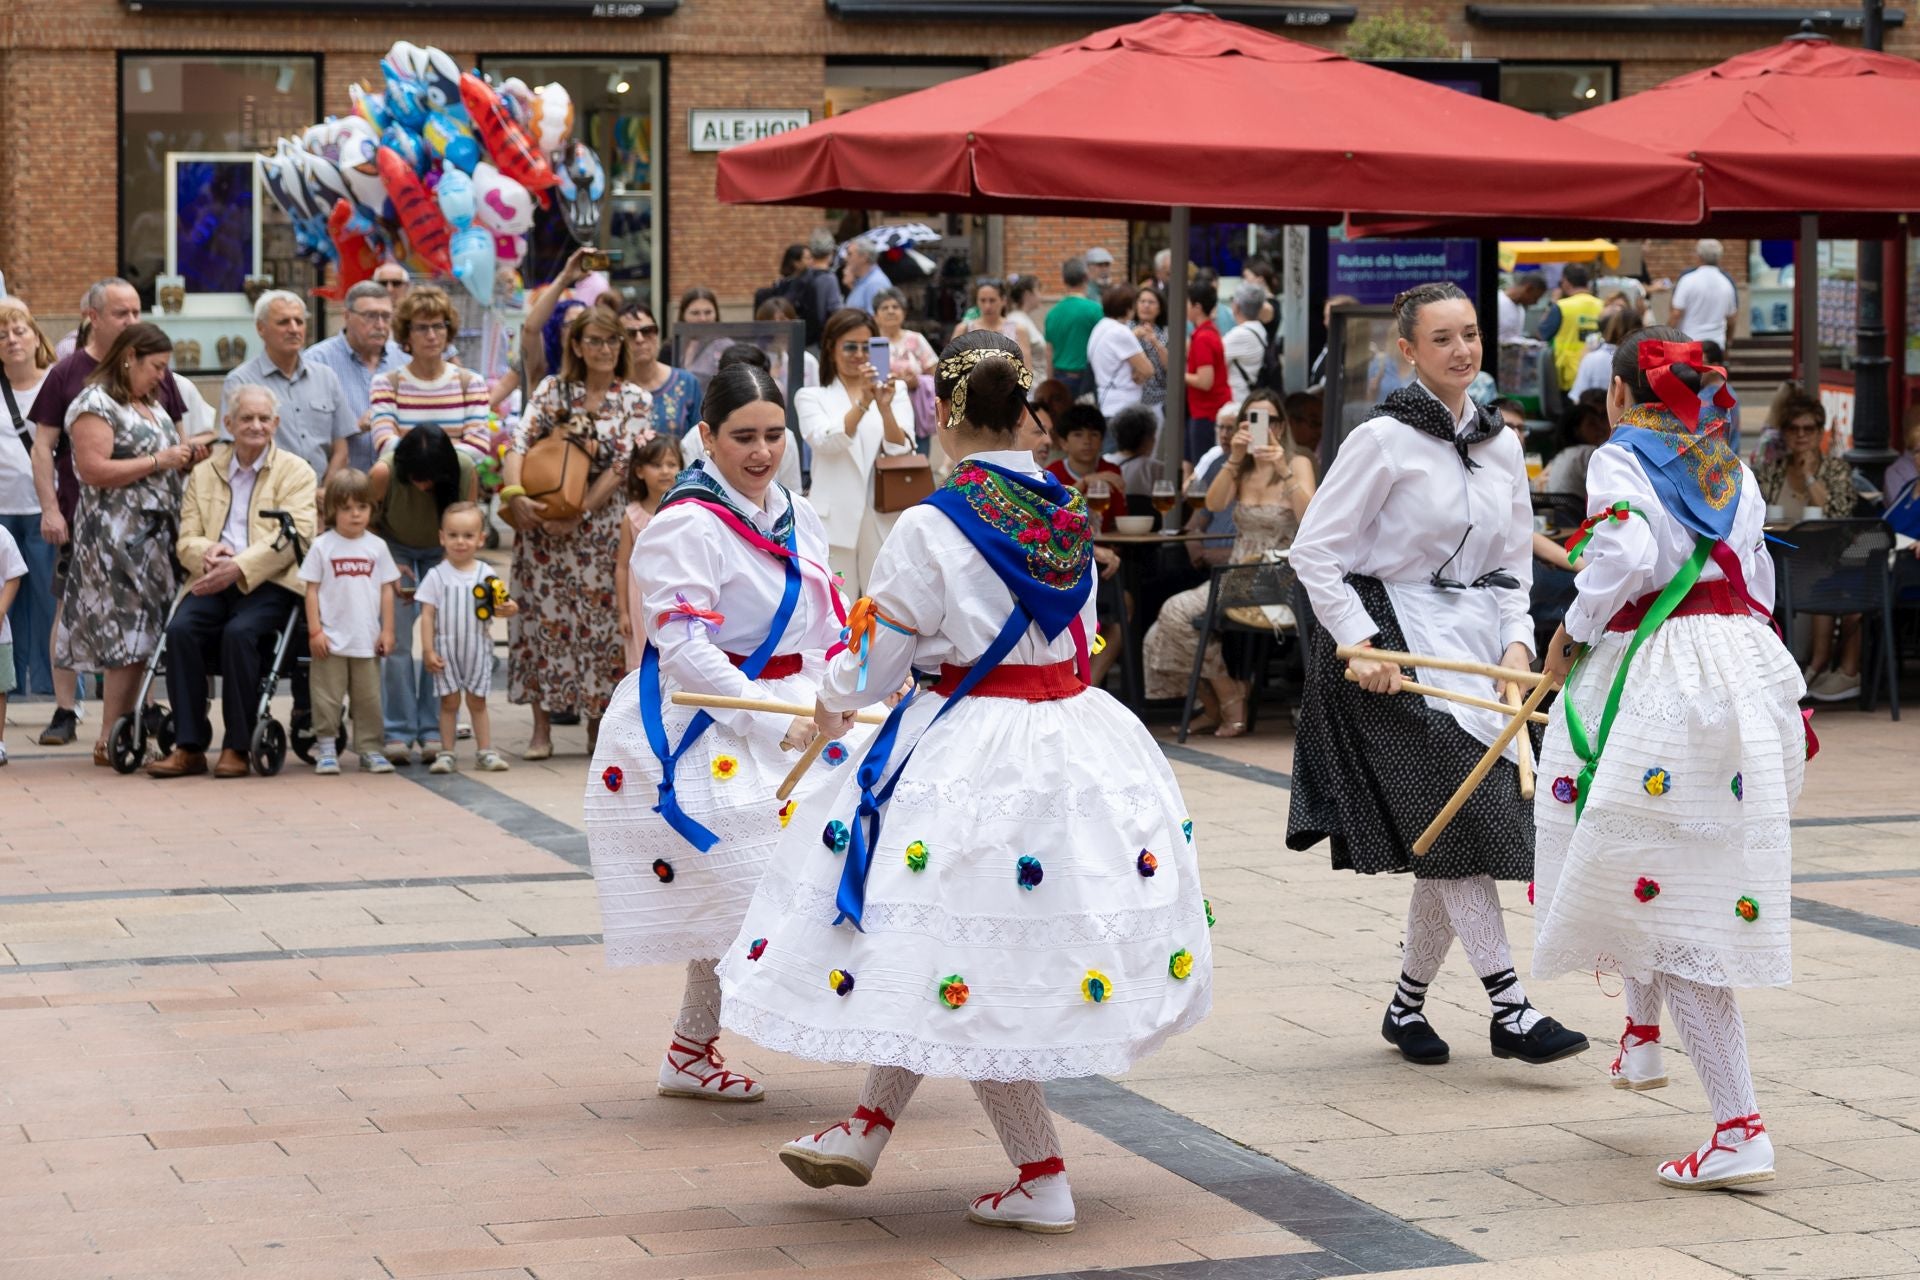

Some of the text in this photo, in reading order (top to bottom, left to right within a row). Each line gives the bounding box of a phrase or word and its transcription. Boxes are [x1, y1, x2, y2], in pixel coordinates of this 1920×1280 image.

[1337, 254, 1446, 270] Rutas de Igualdad
